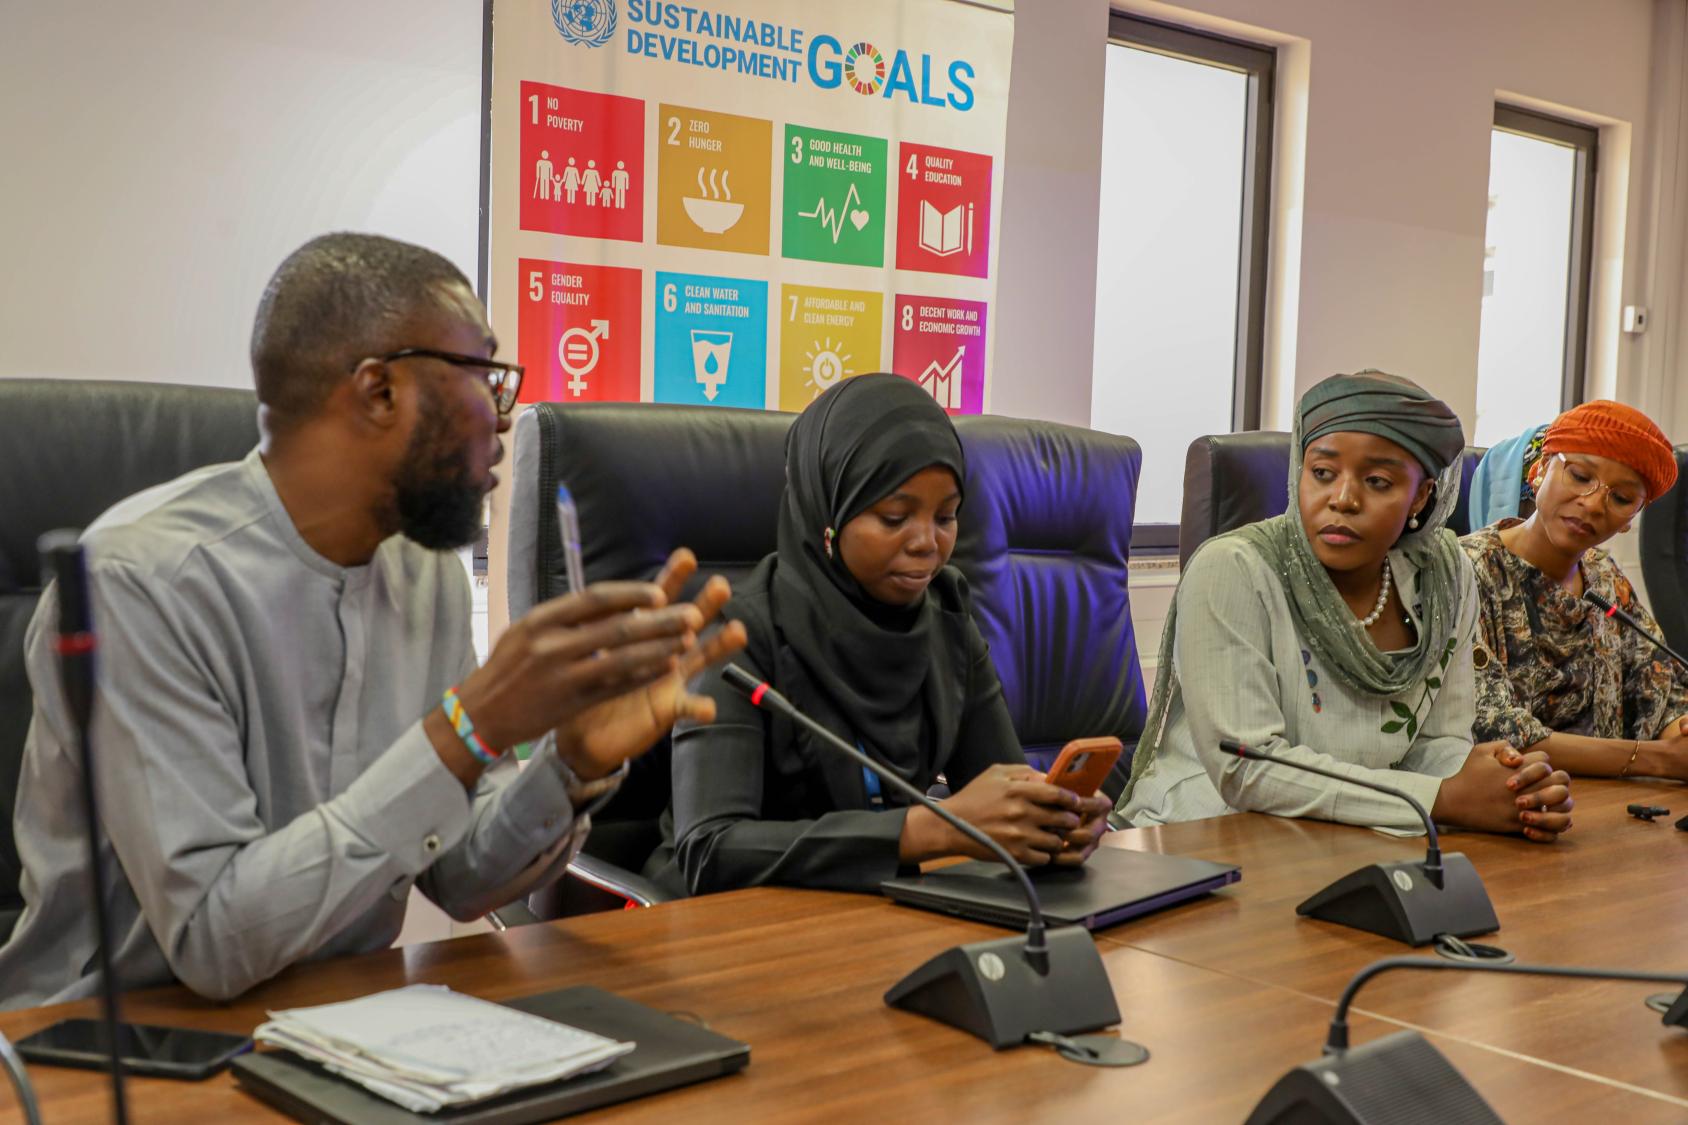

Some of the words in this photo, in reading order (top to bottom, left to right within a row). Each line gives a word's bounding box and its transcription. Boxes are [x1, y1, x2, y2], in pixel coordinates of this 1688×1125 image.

[627, 0, 803, 53] SUSTAINABLE
[627, 29, 802, 83] DEVELOPMENT
[807, 34, 975, 112] GOALS
[528, 95, 539, 125] 1
[547, 97, 558, 111] NO
[547, 115, 584, 133] POVERTY
[667, 117, 681, 146] 2
[689, 119, 710, 134] ZERO
[689, 136, 722, 152] HUNGER
[791, 136, 803, 164] 3
[809, 139, 831, 152] GOOD
[833, 142, 862, 157] HEALTH
[809, 155, 824, 168] AND
[826, 157, 872, 174] WELL-BEING
[906, 154, 918, 180] 4
[925, 155, 954, 170] QUALITY
[925, 171, 962, 187] EDUCATION
[529, 271, 543, 302] 5
[551, 273, 583, 288] GENDER
[551, 291, 590, 307] EQUALITY
[663, 283, 677, 313] 6
[685, 285, 711, 299] CLEAN
[712, 287, 739, 301] WATER
[684, 302, 702, 315] AND
[703, 303, 749, 318] SANITATION
[788, 295, 798, 322] 7
[803, 296, 849, 311] AFFORDABLE
[849, 300, 866, 313] AND
[803, 312, 825, 324] CLEAN
[826, 314, 854, 327] ENERGY
[901, 305, 914, 331] 8
[919, 306, 946, 318] DECENT
[946, 308, 965, 320] WORK
[965, 310, 978, 322] AND
[919, 321, 955, 334] ECONOMIC
[955, 323, 981, 337] GROWTH
